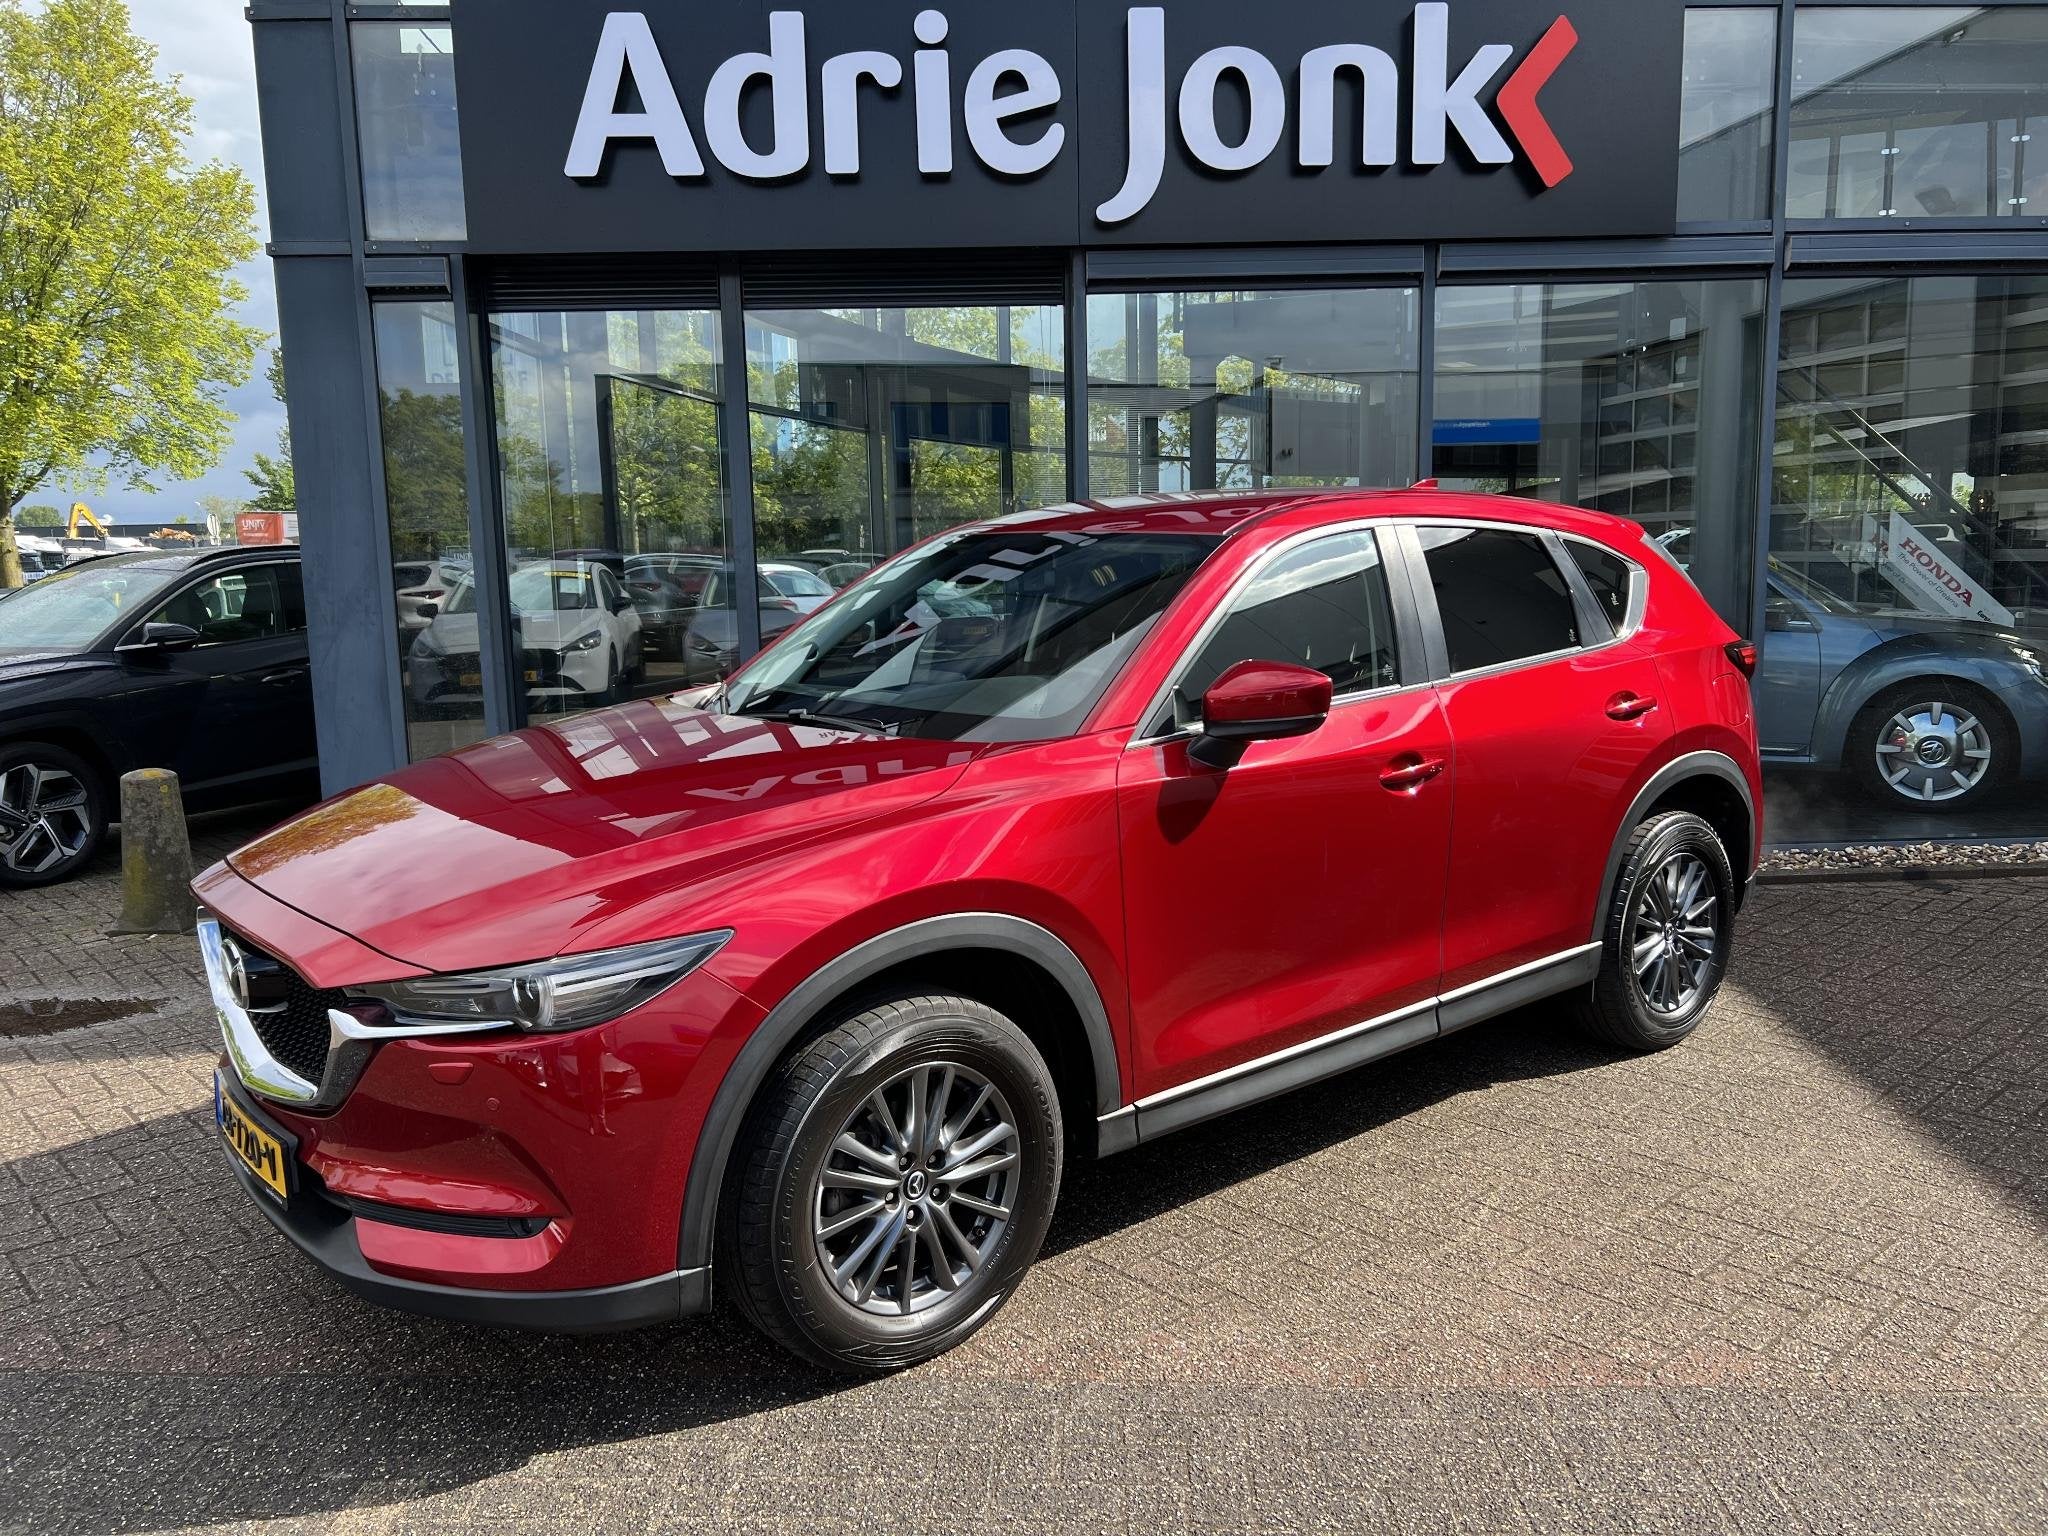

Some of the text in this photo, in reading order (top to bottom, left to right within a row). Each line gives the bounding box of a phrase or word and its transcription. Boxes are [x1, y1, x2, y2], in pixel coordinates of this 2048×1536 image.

[563, 2, 1514, 222] Adrie Jonk
[1898, 552, 1910, 565] The
[1909, 562, 1929, 581] Power
[1928, 578, 1937, 587] of
[1935, 585, 1959, 608] Dreams
[1899, 537, 1973, 607] HONDA
